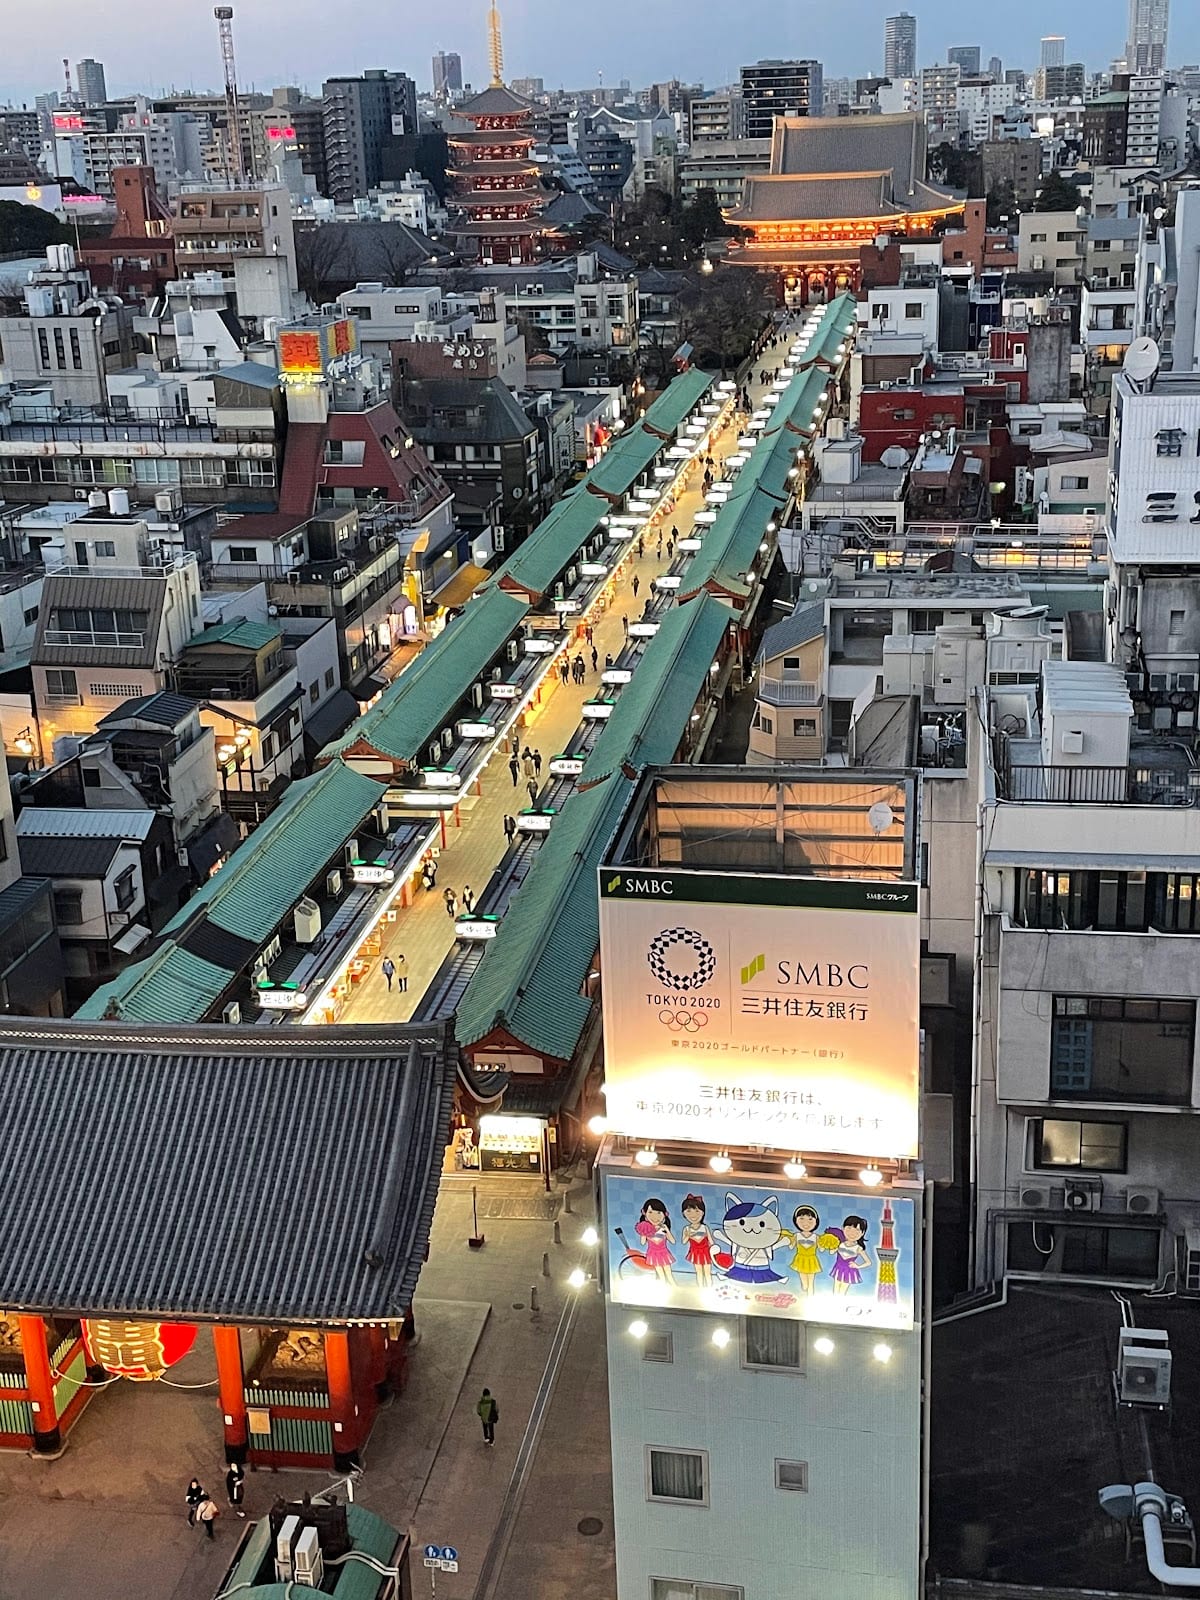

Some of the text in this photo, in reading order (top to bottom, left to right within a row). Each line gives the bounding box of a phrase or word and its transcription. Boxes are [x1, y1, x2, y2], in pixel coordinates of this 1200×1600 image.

[625, 878, 674, 895] SMBC
[866, 892, 910, 902] SMBCグループ
[777, 960, 869, 990] SMBC
[646, 993, 721, 1009] TOKYO 2020
[740, 996, 869, 1021] 三井住友銀行
[699, 1084, 823, 1107] 三井住友銀行は、
